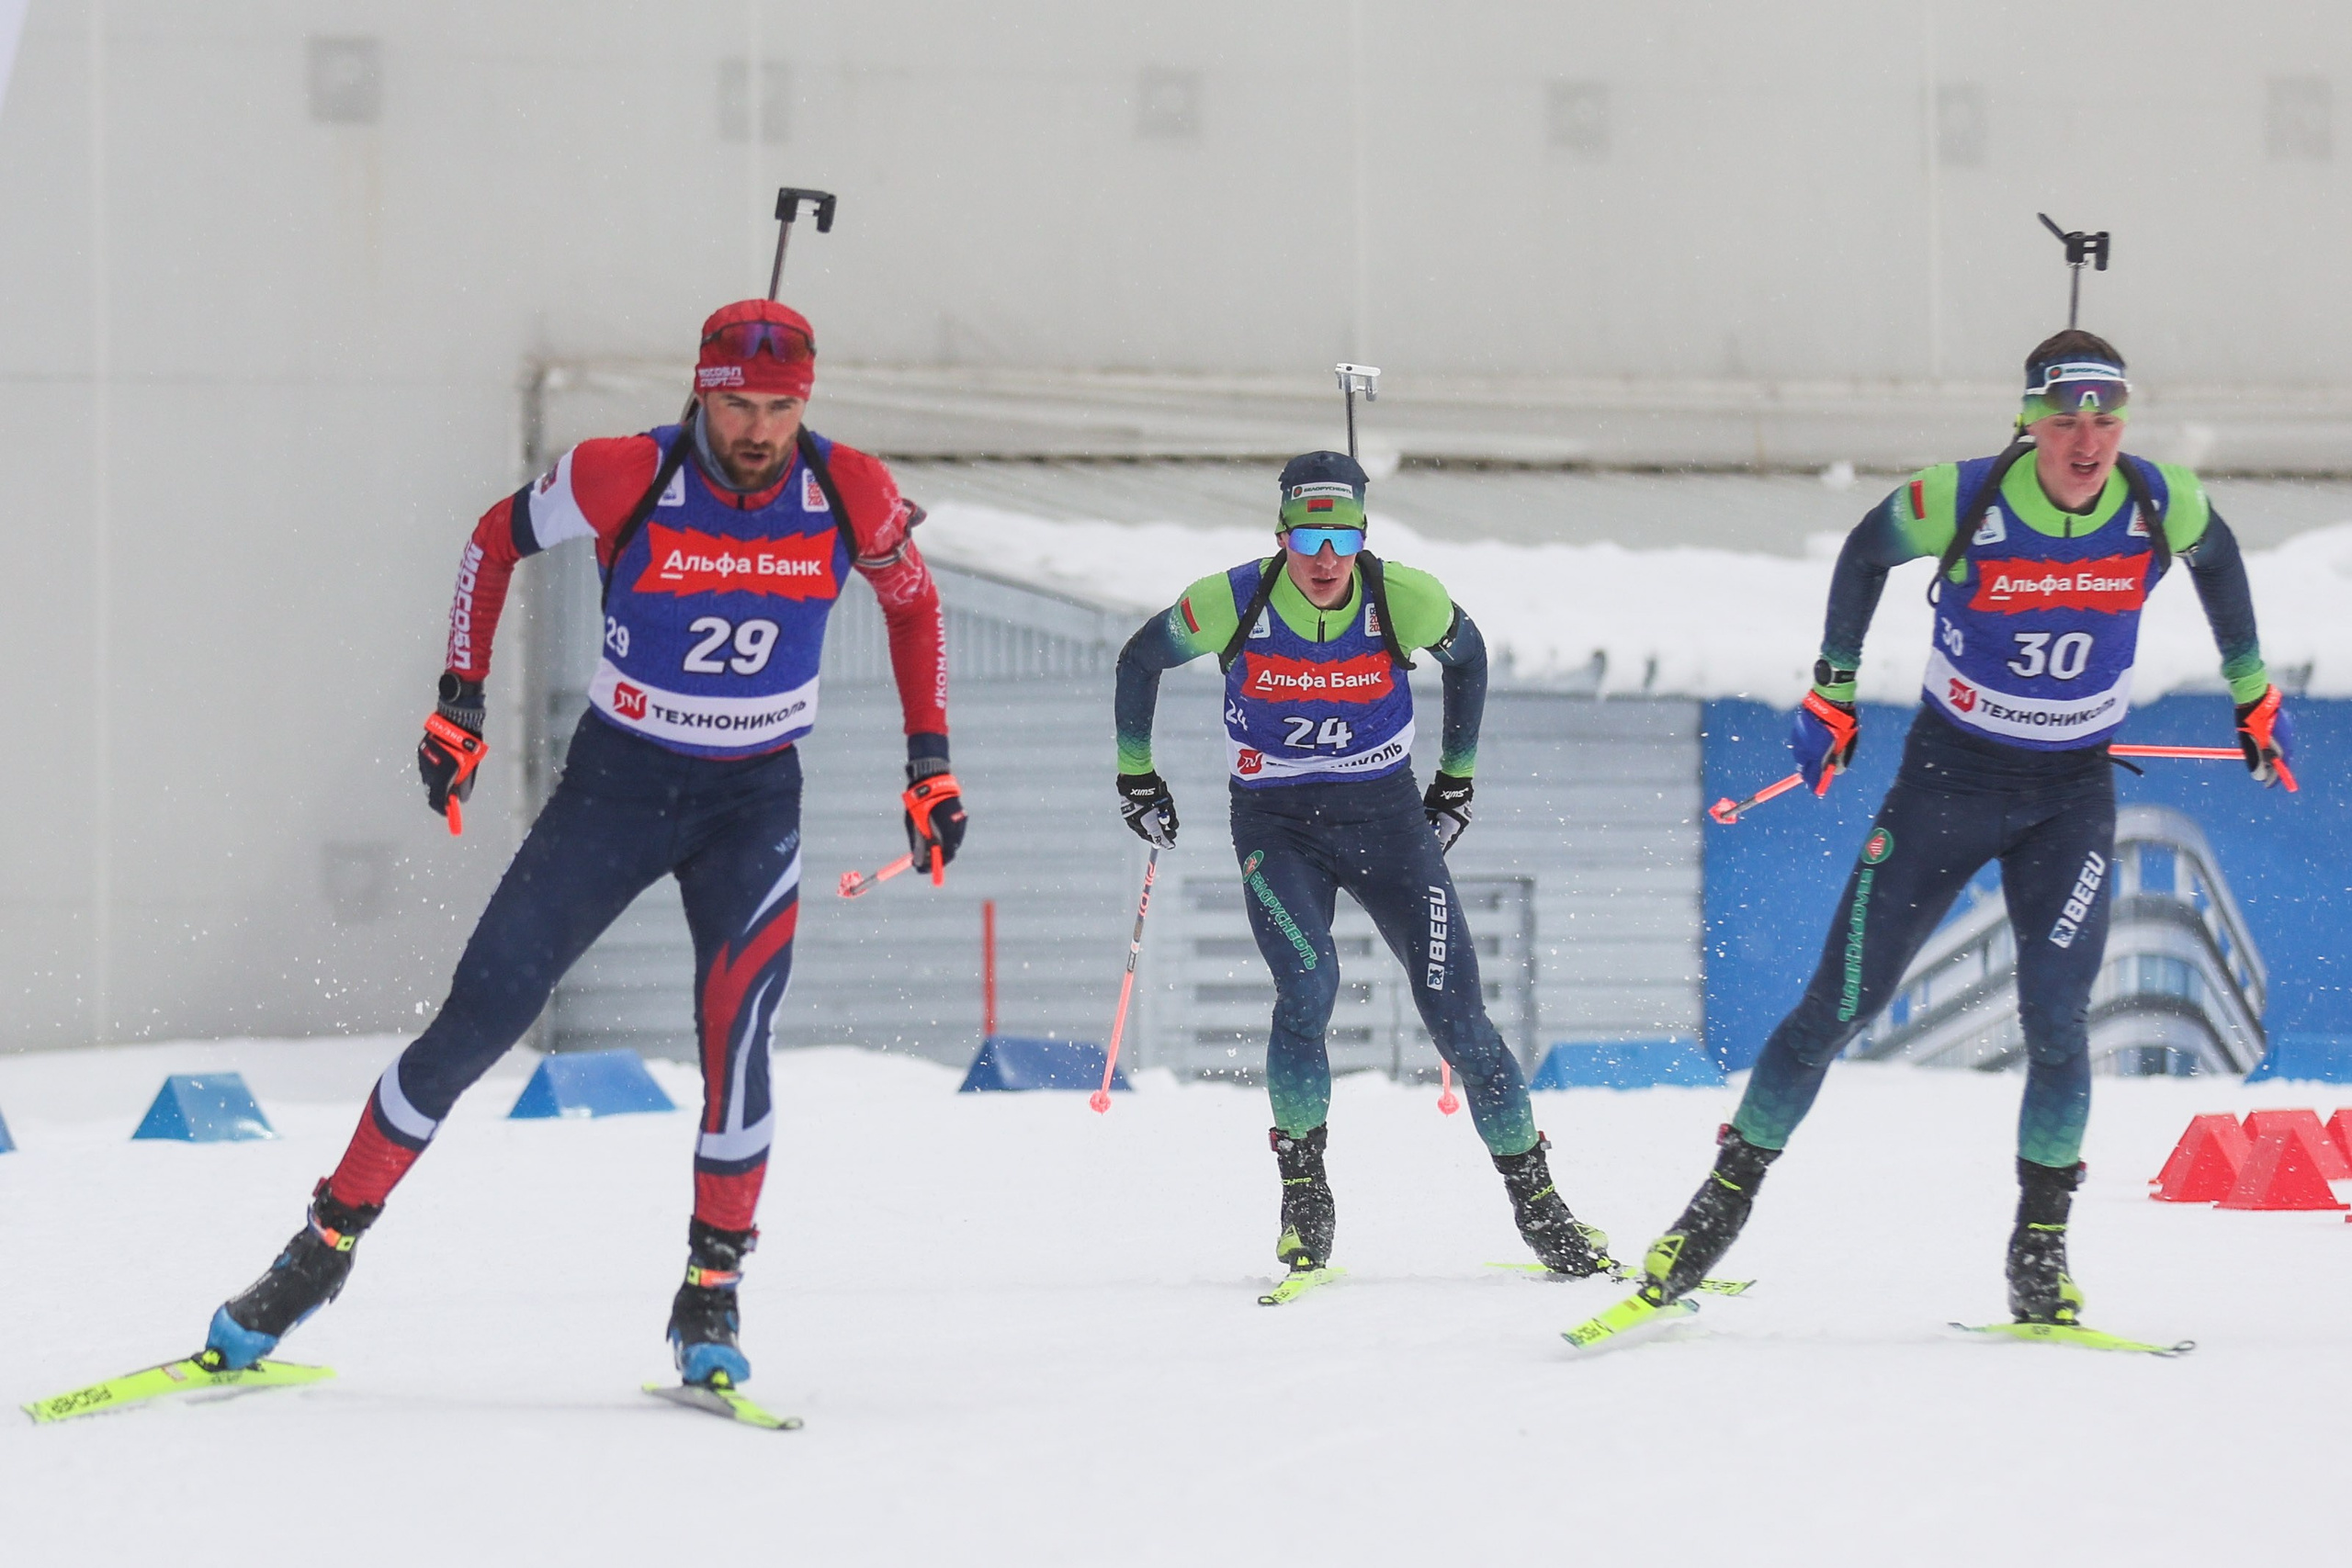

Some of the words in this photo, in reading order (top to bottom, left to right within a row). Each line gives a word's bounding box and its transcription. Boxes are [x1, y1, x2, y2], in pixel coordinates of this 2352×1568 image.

[661, 549, 752, 580] Альфа
[757, 553, 822, 576] Банк
[1989, 574, 2072, 600] Альфа
[2075, 572, 2136, 592] Банк
[605, 615, 630, 658] 29
[683, 615, 780, 676] 29
[1941, 617, 1964, 657] 30
[2007, 631, 2095, 681] 30
[1256, 670, 1327, 691] Альфа
[1330, 671, 1383, 688] Банк
[651, 700, 807, 730] ТЕХНОНИКОЛЬ
[1226, 699, 1249, 731] 24
[1981, 698, 2116, 727] ТЕХНОНИКОЛЬ
[1283, 716, 1353, 750] 24
[2062, 851, 2106, 923] BEEU
[1250, 871, 1319, 970] БЕЛОРУСНЕФТЬ
[1428, 885, 1448, 963] BEEU
